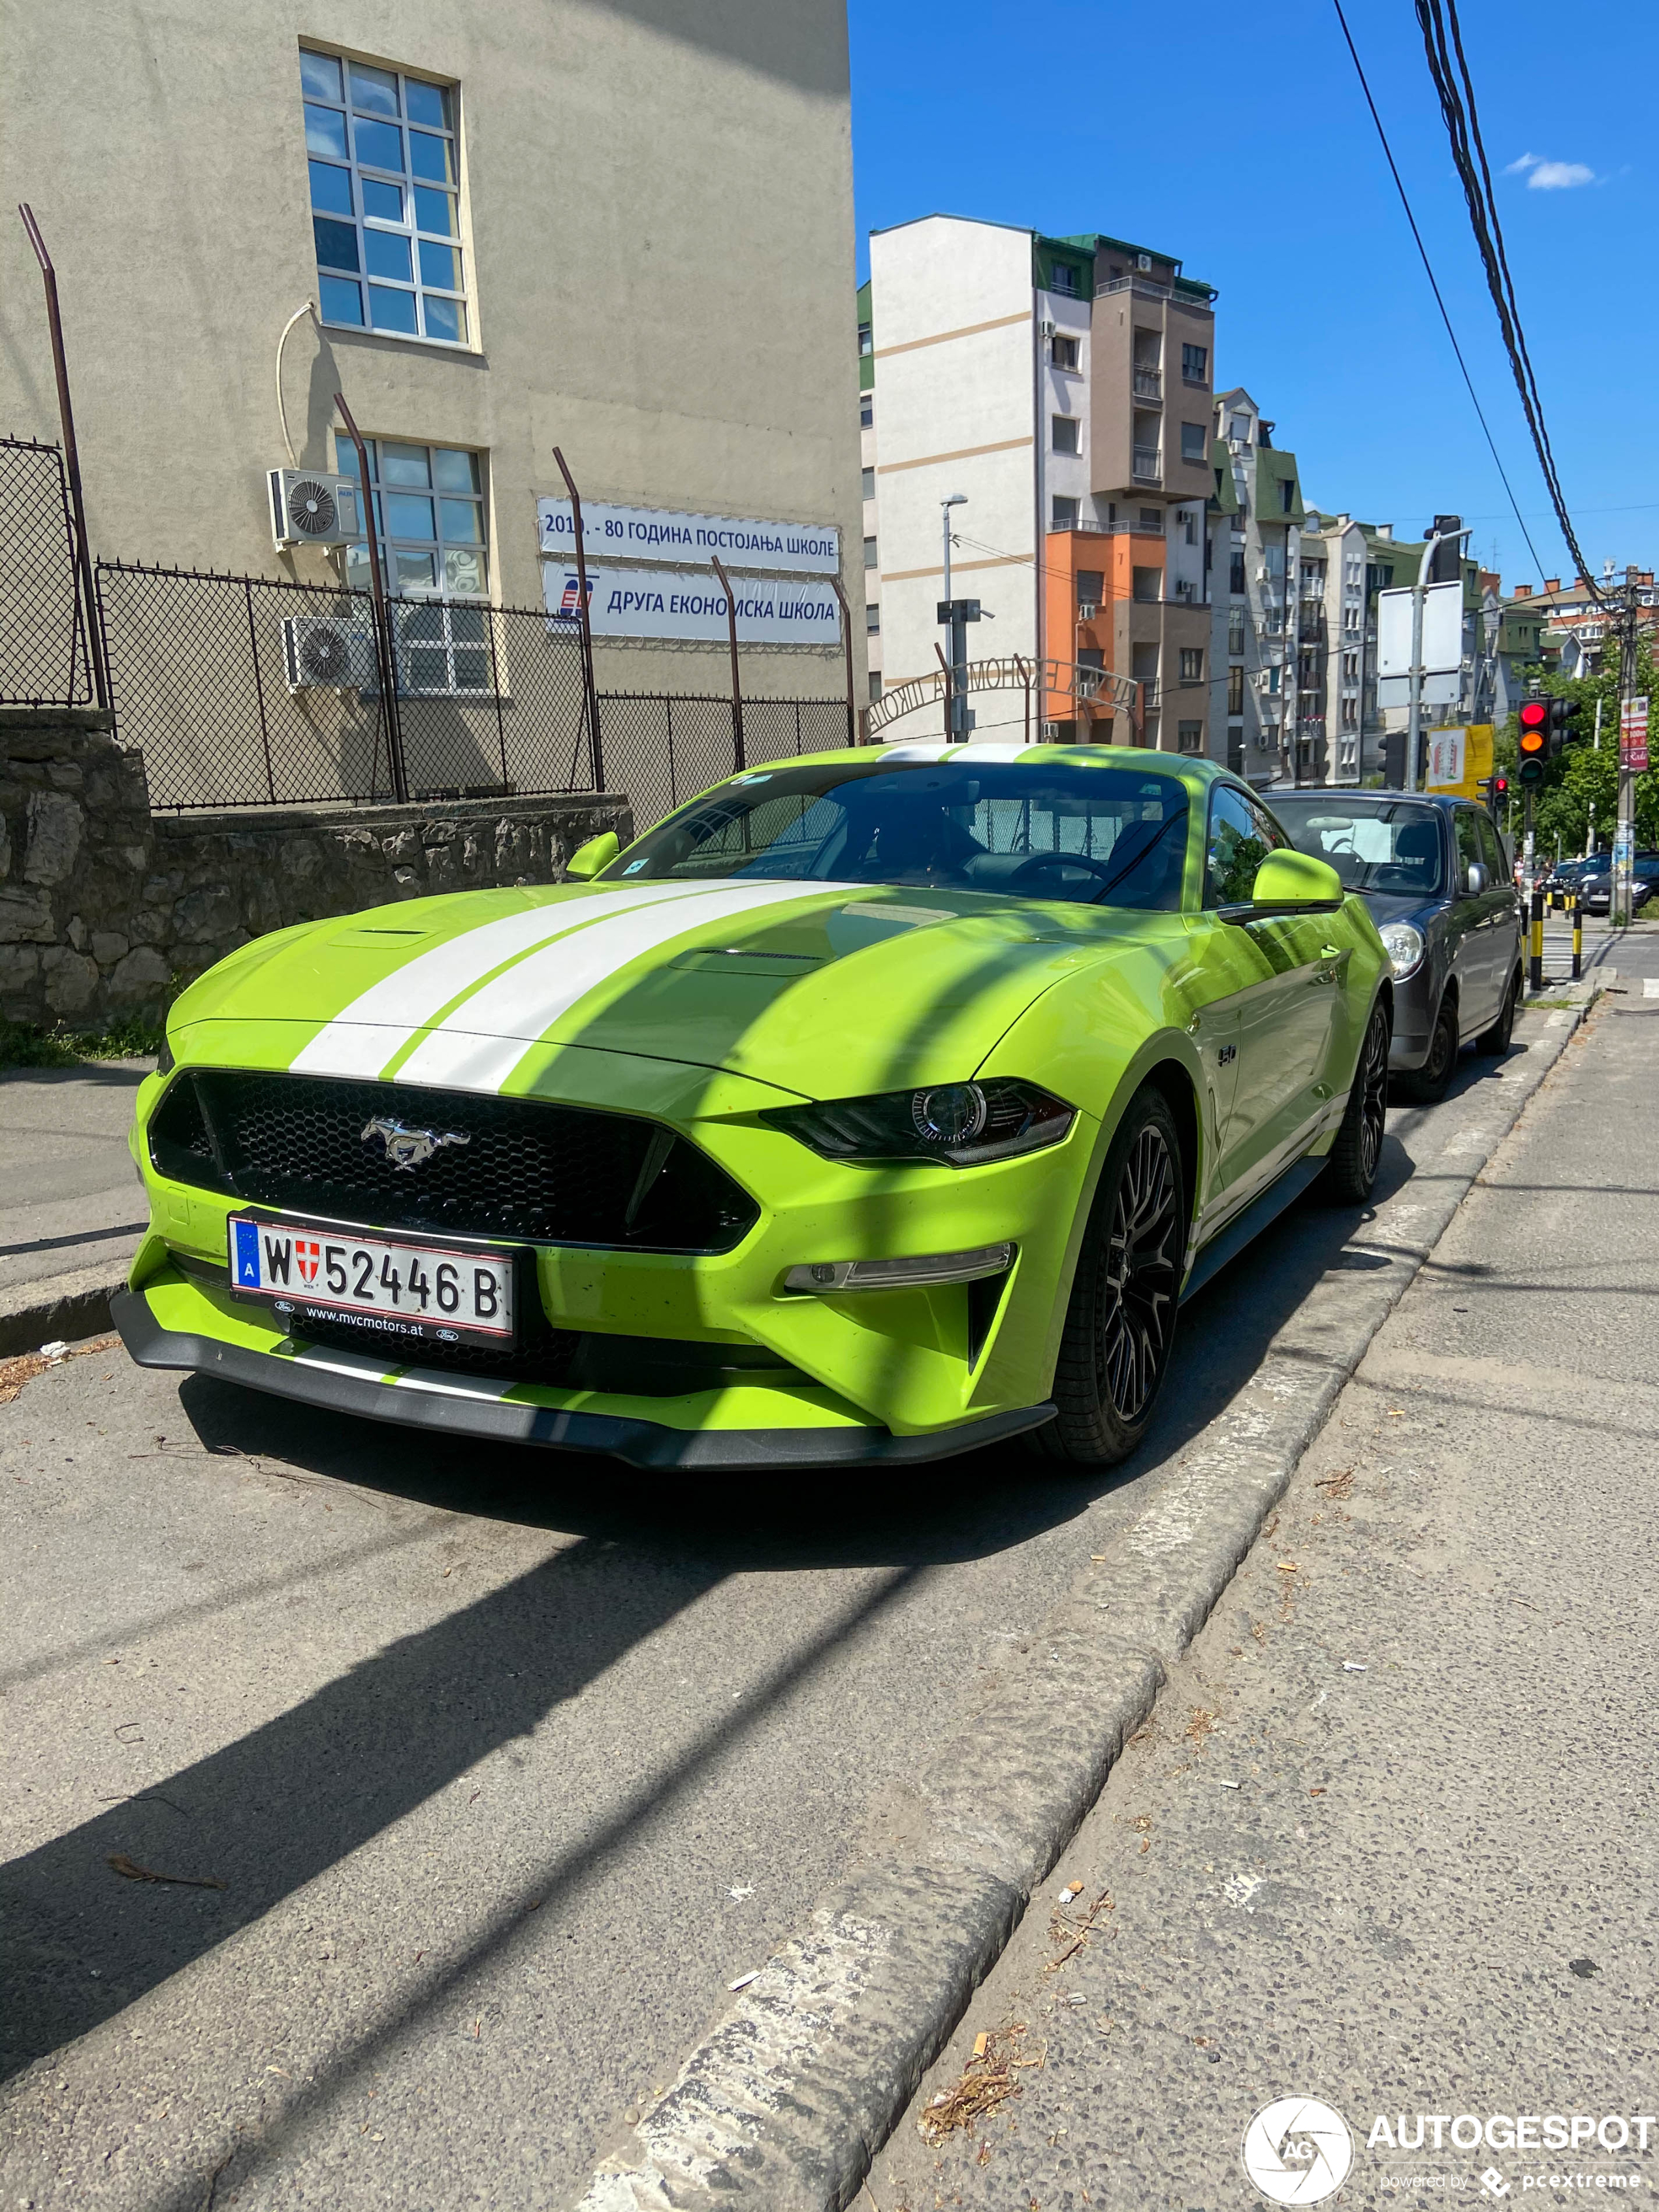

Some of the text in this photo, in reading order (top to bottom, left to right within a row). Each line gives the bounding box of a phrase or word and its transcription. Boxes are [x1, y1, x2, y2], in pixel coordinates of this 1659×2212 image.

[605, 520, 624, 537] 80
[629, 522, 692, 545] ГОДИНА
[697, 529, 783, 553] ПОСТОЈАЊА
[787, 538, 834, 557] ШКОЛЕ
[607, 590, 664, 615] ДРУГА
[779, 601, 834, 620] ШКОЛА
[244, 1262, 255, 1277] A
[265, 1235, 499, 1319] W 52446 B
[306, 1307, 423, 1336] www.mvcmotors.at
